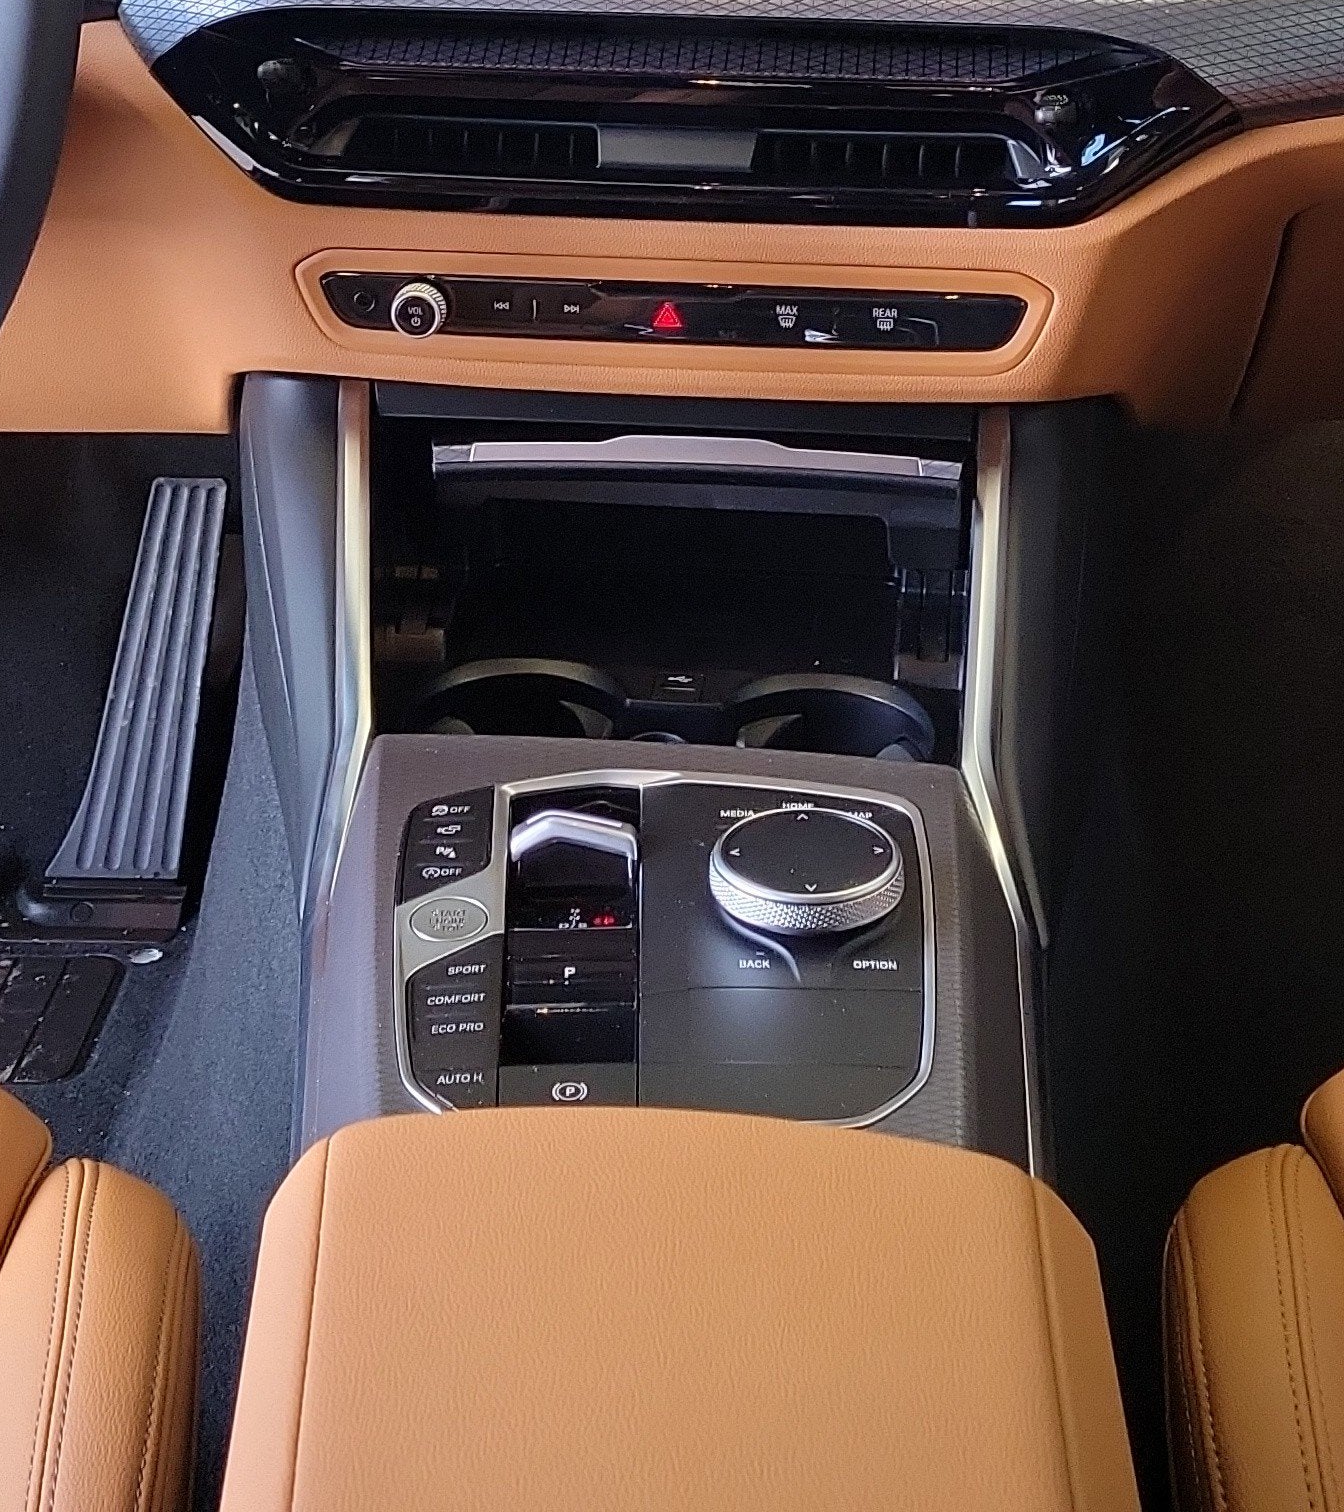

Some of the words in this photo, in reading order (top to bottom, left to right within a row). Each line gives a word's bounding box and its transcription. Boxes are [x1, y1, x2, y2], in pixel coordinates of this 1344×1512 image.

[408, 306, 423, 316] VOL
[775, 304, 798, 316] MAX
[872, 307, 898, 318] REAR
[449, 805, 471, 815] OFF
[720, 809, 755, 818] MEDIA
[440, 868, 463, 877] OFF
[739, 959, 771, 969] BACK
[852, 960, 898, 971] OPTION
[447, 964, 487, 976] SPORT
[564, 967, 576, 979] P
[427, 992, 486, 1006] COMFORT
[431, 1024, 456, 1035] ECO
[459, 1022, 485, 1033] PRO
[436, 1073, 471, 1085] AUTO
